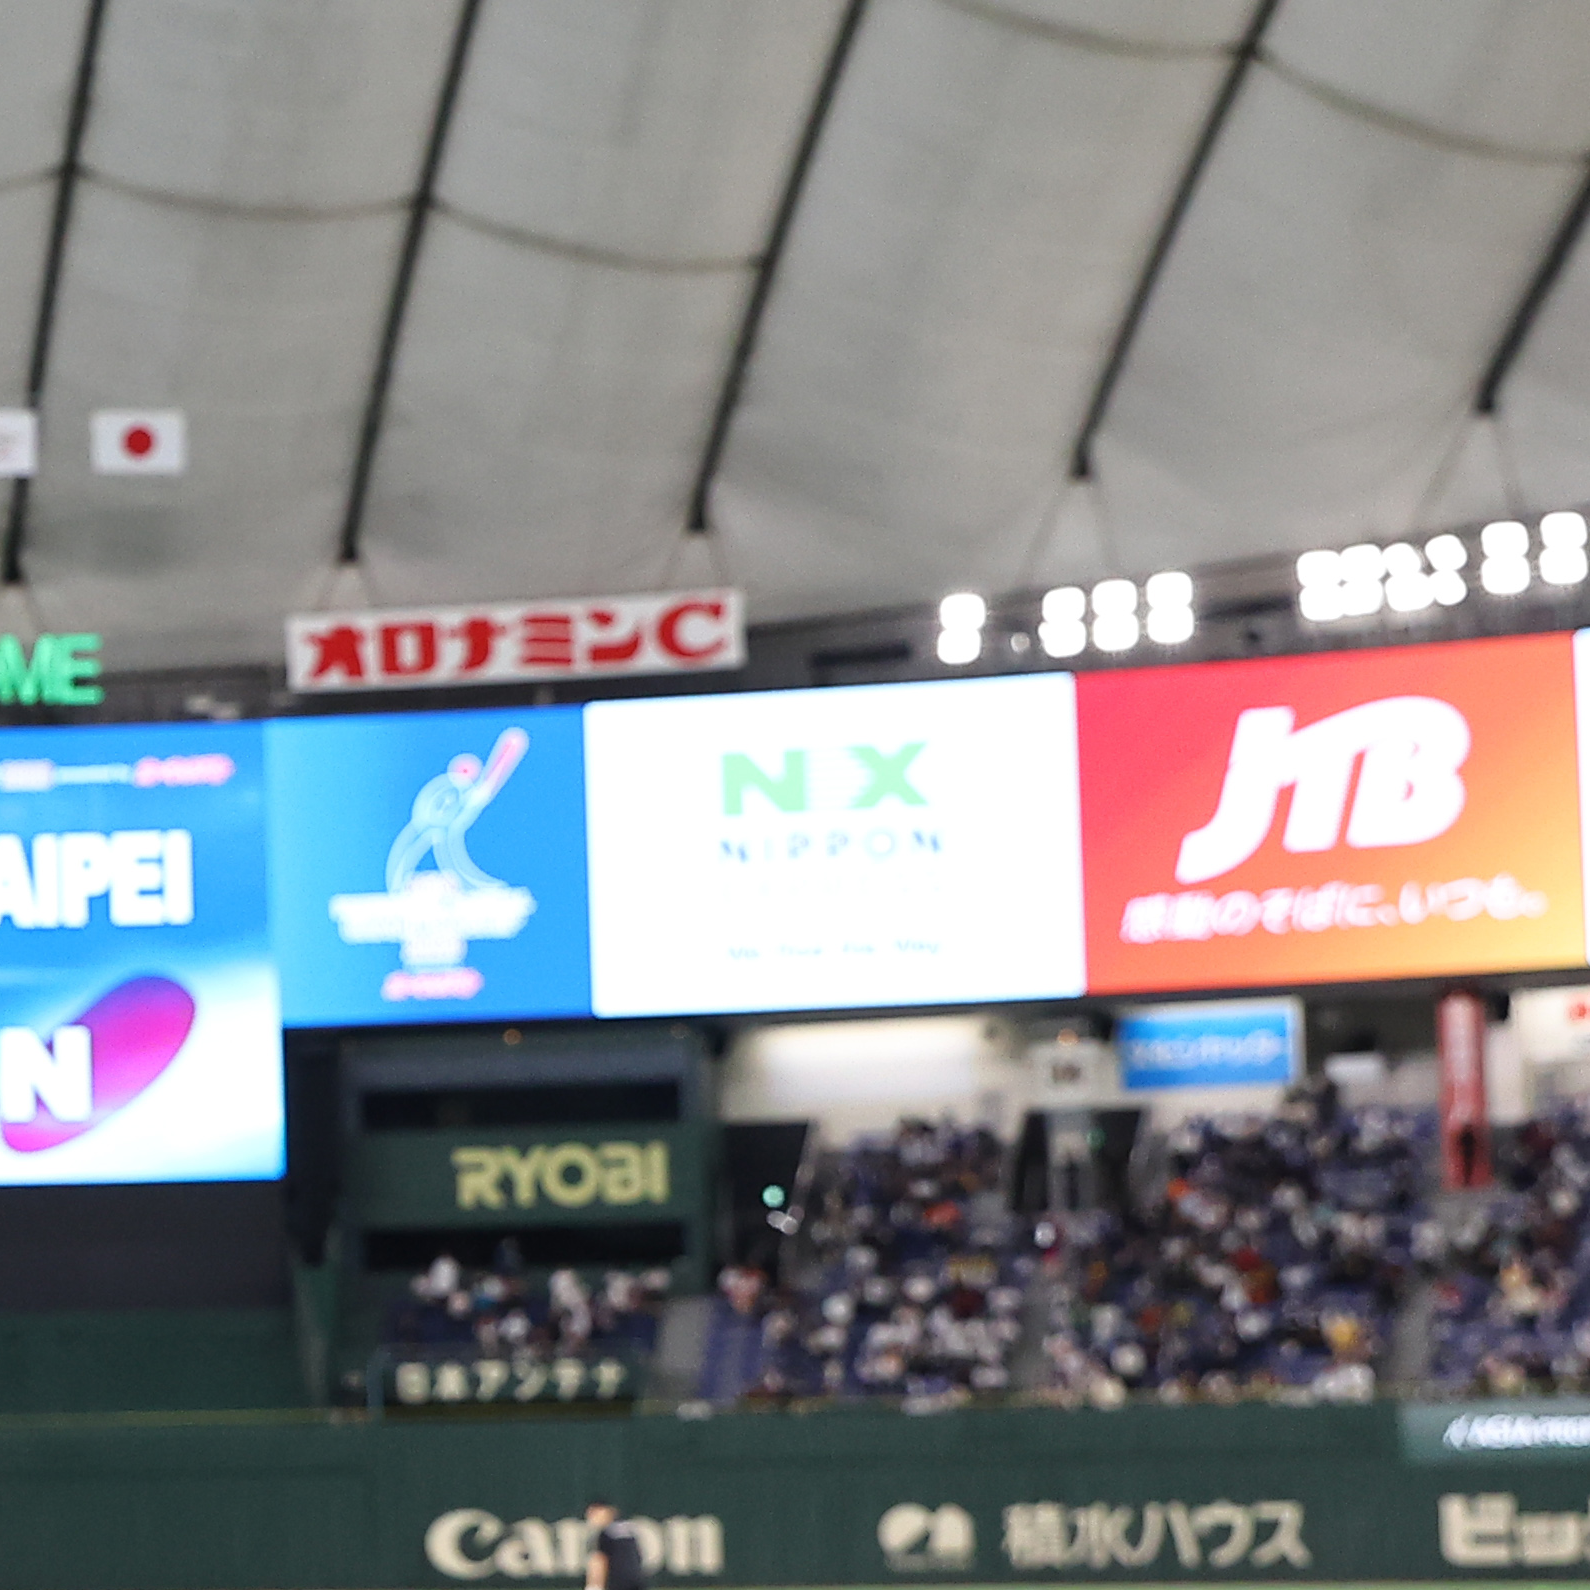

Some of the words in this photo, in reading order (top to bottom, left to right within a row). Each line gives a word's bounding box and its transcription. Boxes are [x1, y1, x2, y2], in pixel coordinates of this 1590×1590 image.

[305, 600, 726, 680] オロナミンC
[720, 740, 930, 818] NX
[1172, 695, 1472, 886] JTB
[451, 1140, 670, 1210] RYOBI
[1000, 1500, 1313, 1569] 積水ハウス
